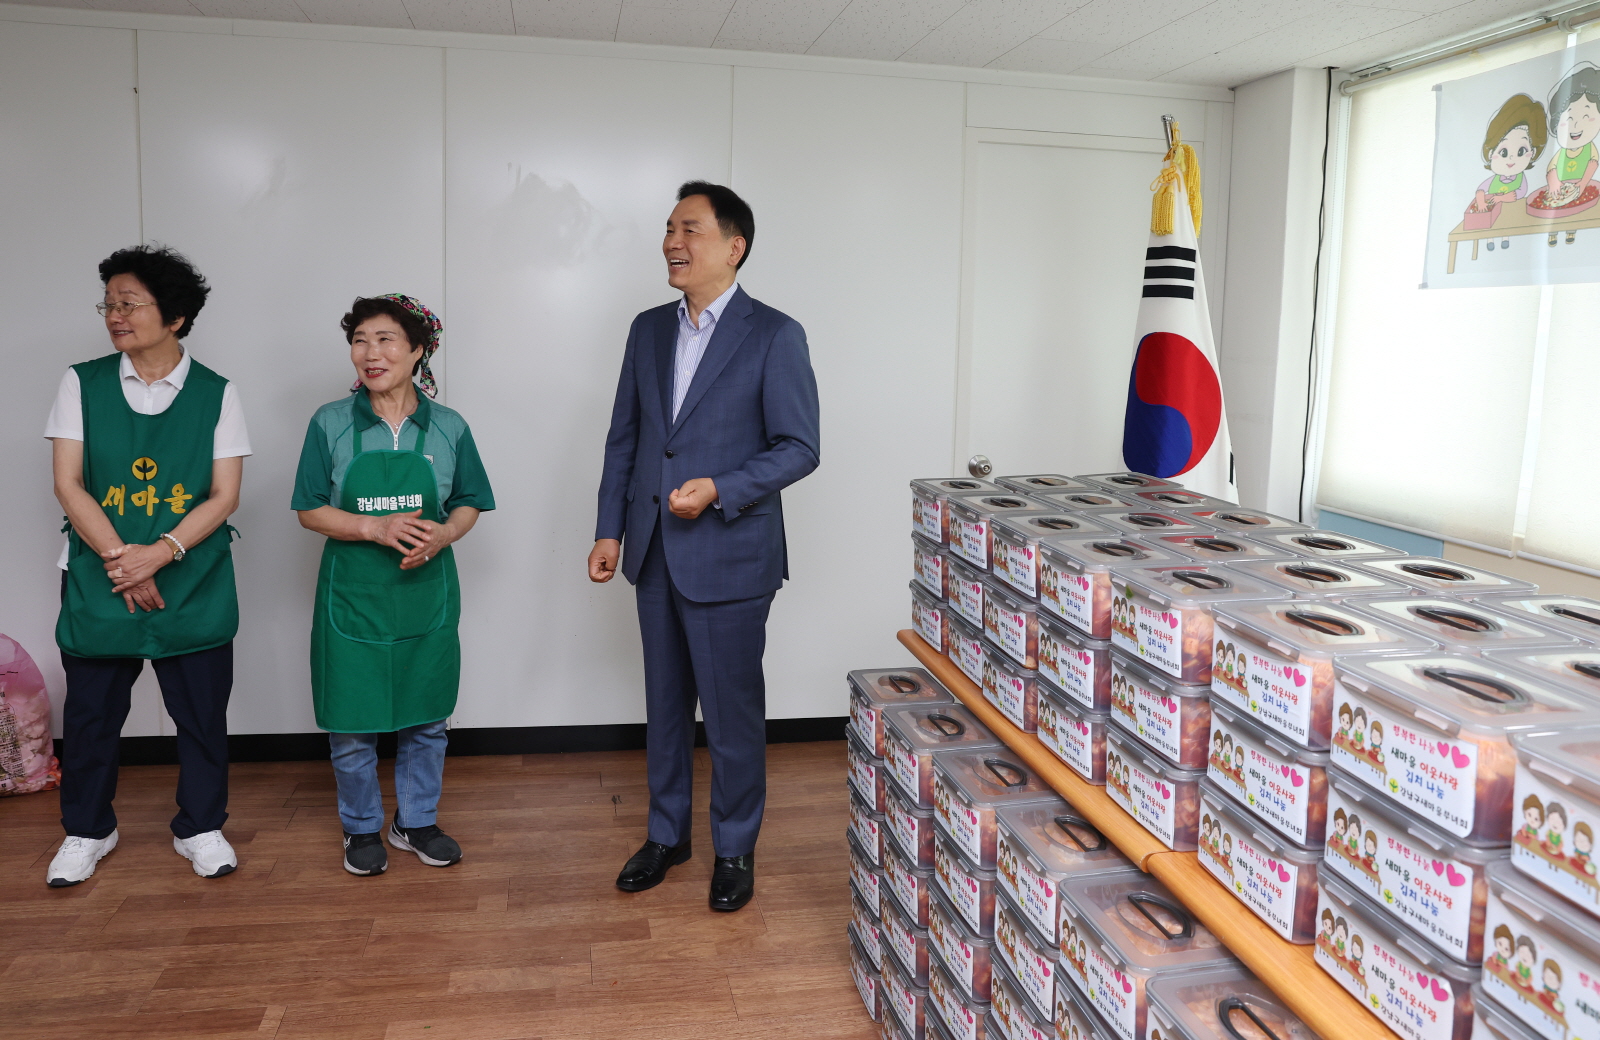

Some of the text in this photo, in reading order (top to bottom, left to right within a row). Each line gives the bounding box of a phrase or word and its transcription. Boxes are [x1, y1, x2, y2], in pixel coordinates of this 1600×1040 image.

[101, 483, 193, 516] 새마을
[356, 494, 423, 512] 강남새마을부녀회
[1153, 612, 1161, 621] 나눔
[1139, 622, 1173, 645] 새마을 이웃사랑
[1147, 636, 1166, 653] 김치 나눔
[1253, 655, 1282, 677] 행복한 나눔
[1152, 694, 1160, 705] 나눔
[1252, 674, 1298, 705] 새마을 이웃사랑
[1262, 691, 1288, 714] 김치 나눔
[1138, 702, 1172, 729] 새마을 이웃사랑
[1146, 717, 1165, 736] 김치 나눔
[1393, 725, 1435, 754] 행복한 나눔
[1251, 750, 1280, 775] 행복한 나눔
[1391, 747, 1458, 790] 새마을 이웃사랑
[1146, 778, 1154, 789] 나눔
[1249, 768, 1295, 805] 새마을 이웃사랑
[1406, 769, 1444, 799] 김치 나눔
[1133, 783, 1165, 814] 새마을 이웃사랑
[1140, 799, 1159, 820] 김치 나눔
[1259, 786, 1286, 812] 김치 나눔
[1238, 840, 1267, 868] 행복한 나눔
[1387, 836, 1430, 871] 행복한 나눔
[1237, 856, 1282, 899] 새마을 이웃사랑
[1247, 875, 1272, 904] 김치 나눔
[1385, 858, 1453, 910] 새마을 이웃사랑
[1400, 882, 1439, 917] 김치 나눔
[1105, 962, 1113, 977] 나눔
[1373, 943, 1414, 982] 행복한 나눔
[1090, 964, 1126, 1009] 새마을 이웃사랑
[1098, 983, 1119, 1013] 김치 나눔
[1371, 964, 1437, 1023] 새마을 이웃사랑
[1386, 989, 1423, 1028] 김치 나눔
